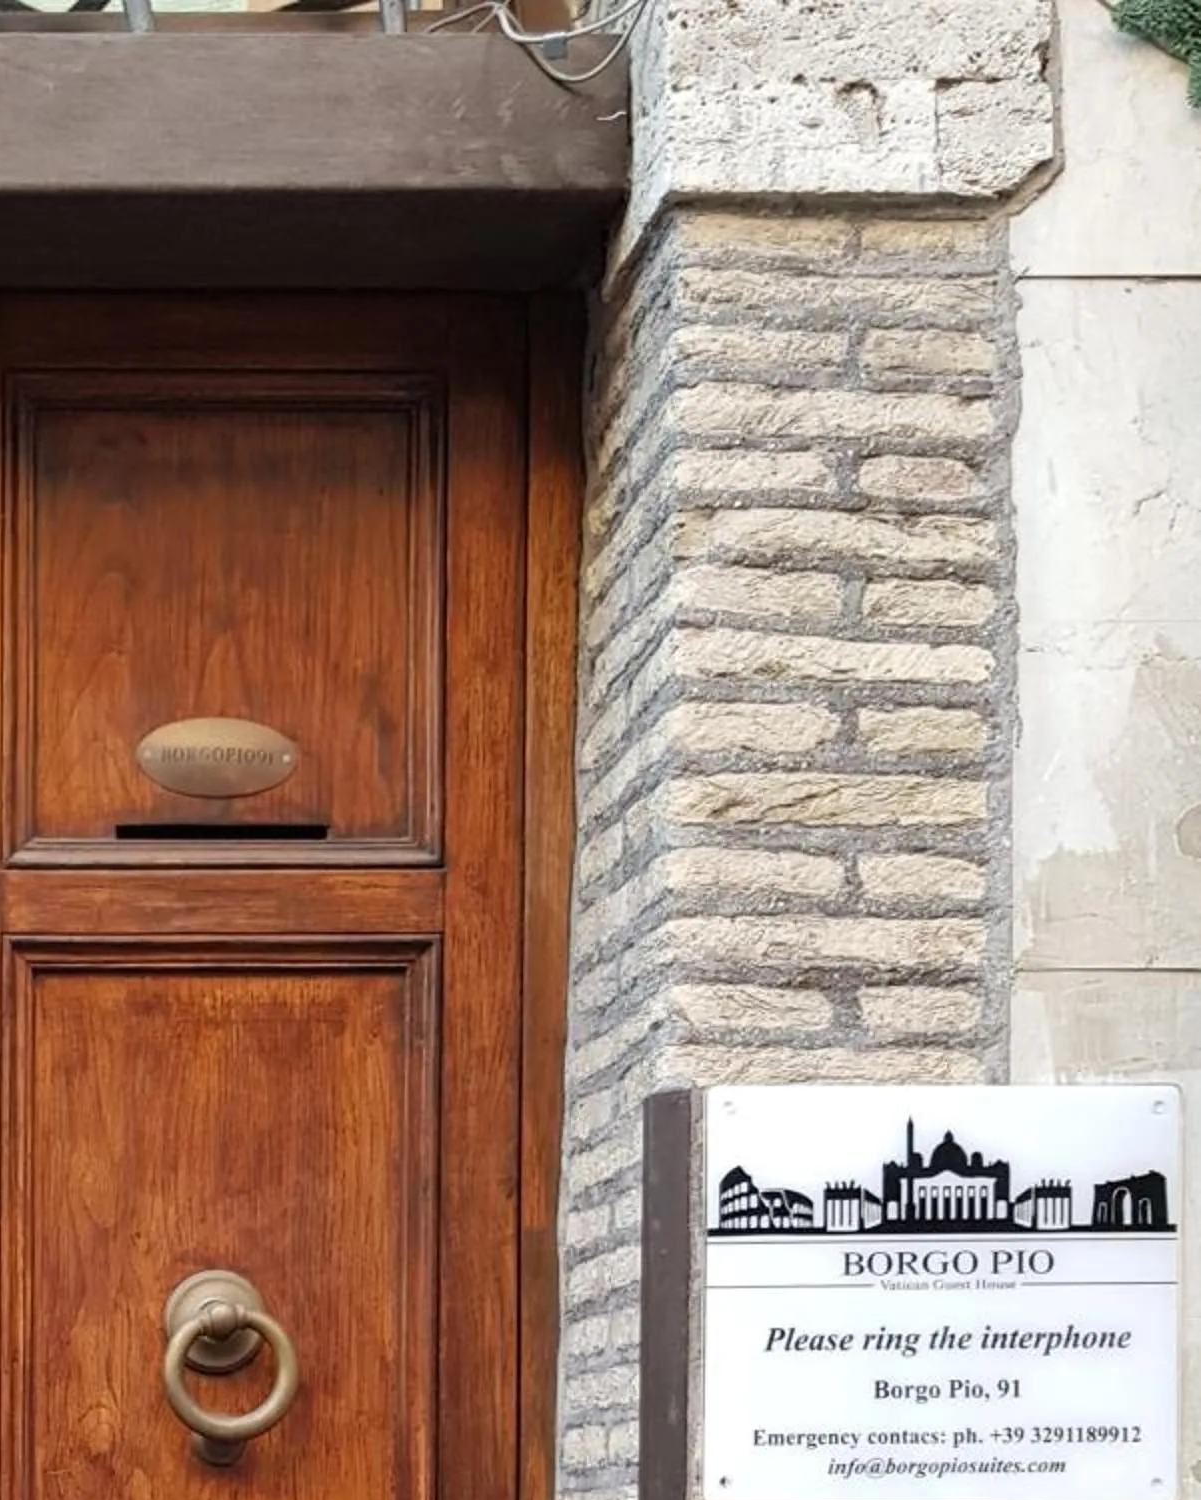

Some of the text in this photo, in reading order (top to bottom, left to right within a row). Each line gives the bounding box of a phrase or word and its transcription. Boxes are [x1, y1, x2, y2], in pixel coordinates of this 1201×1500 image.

[843, 1249, 1055, 1277] BORGO PIO
[879, 1278, 1017, 1291] Vatican Guest House
[764, 1324, 1132, 1357] Please ring the interphone
[873, 1379, 1021, 1404] Borgo Pio, 91
[753, 1428, 861, 1449] Emergency
[953, 1427, 984, 1449] ph.
[990, 1426, 1025, 1445] +39
[1030, 1426, 1142, 1444] 3291189912
[828, 1456, 1067, 1480] info@borgopiosuites.com
